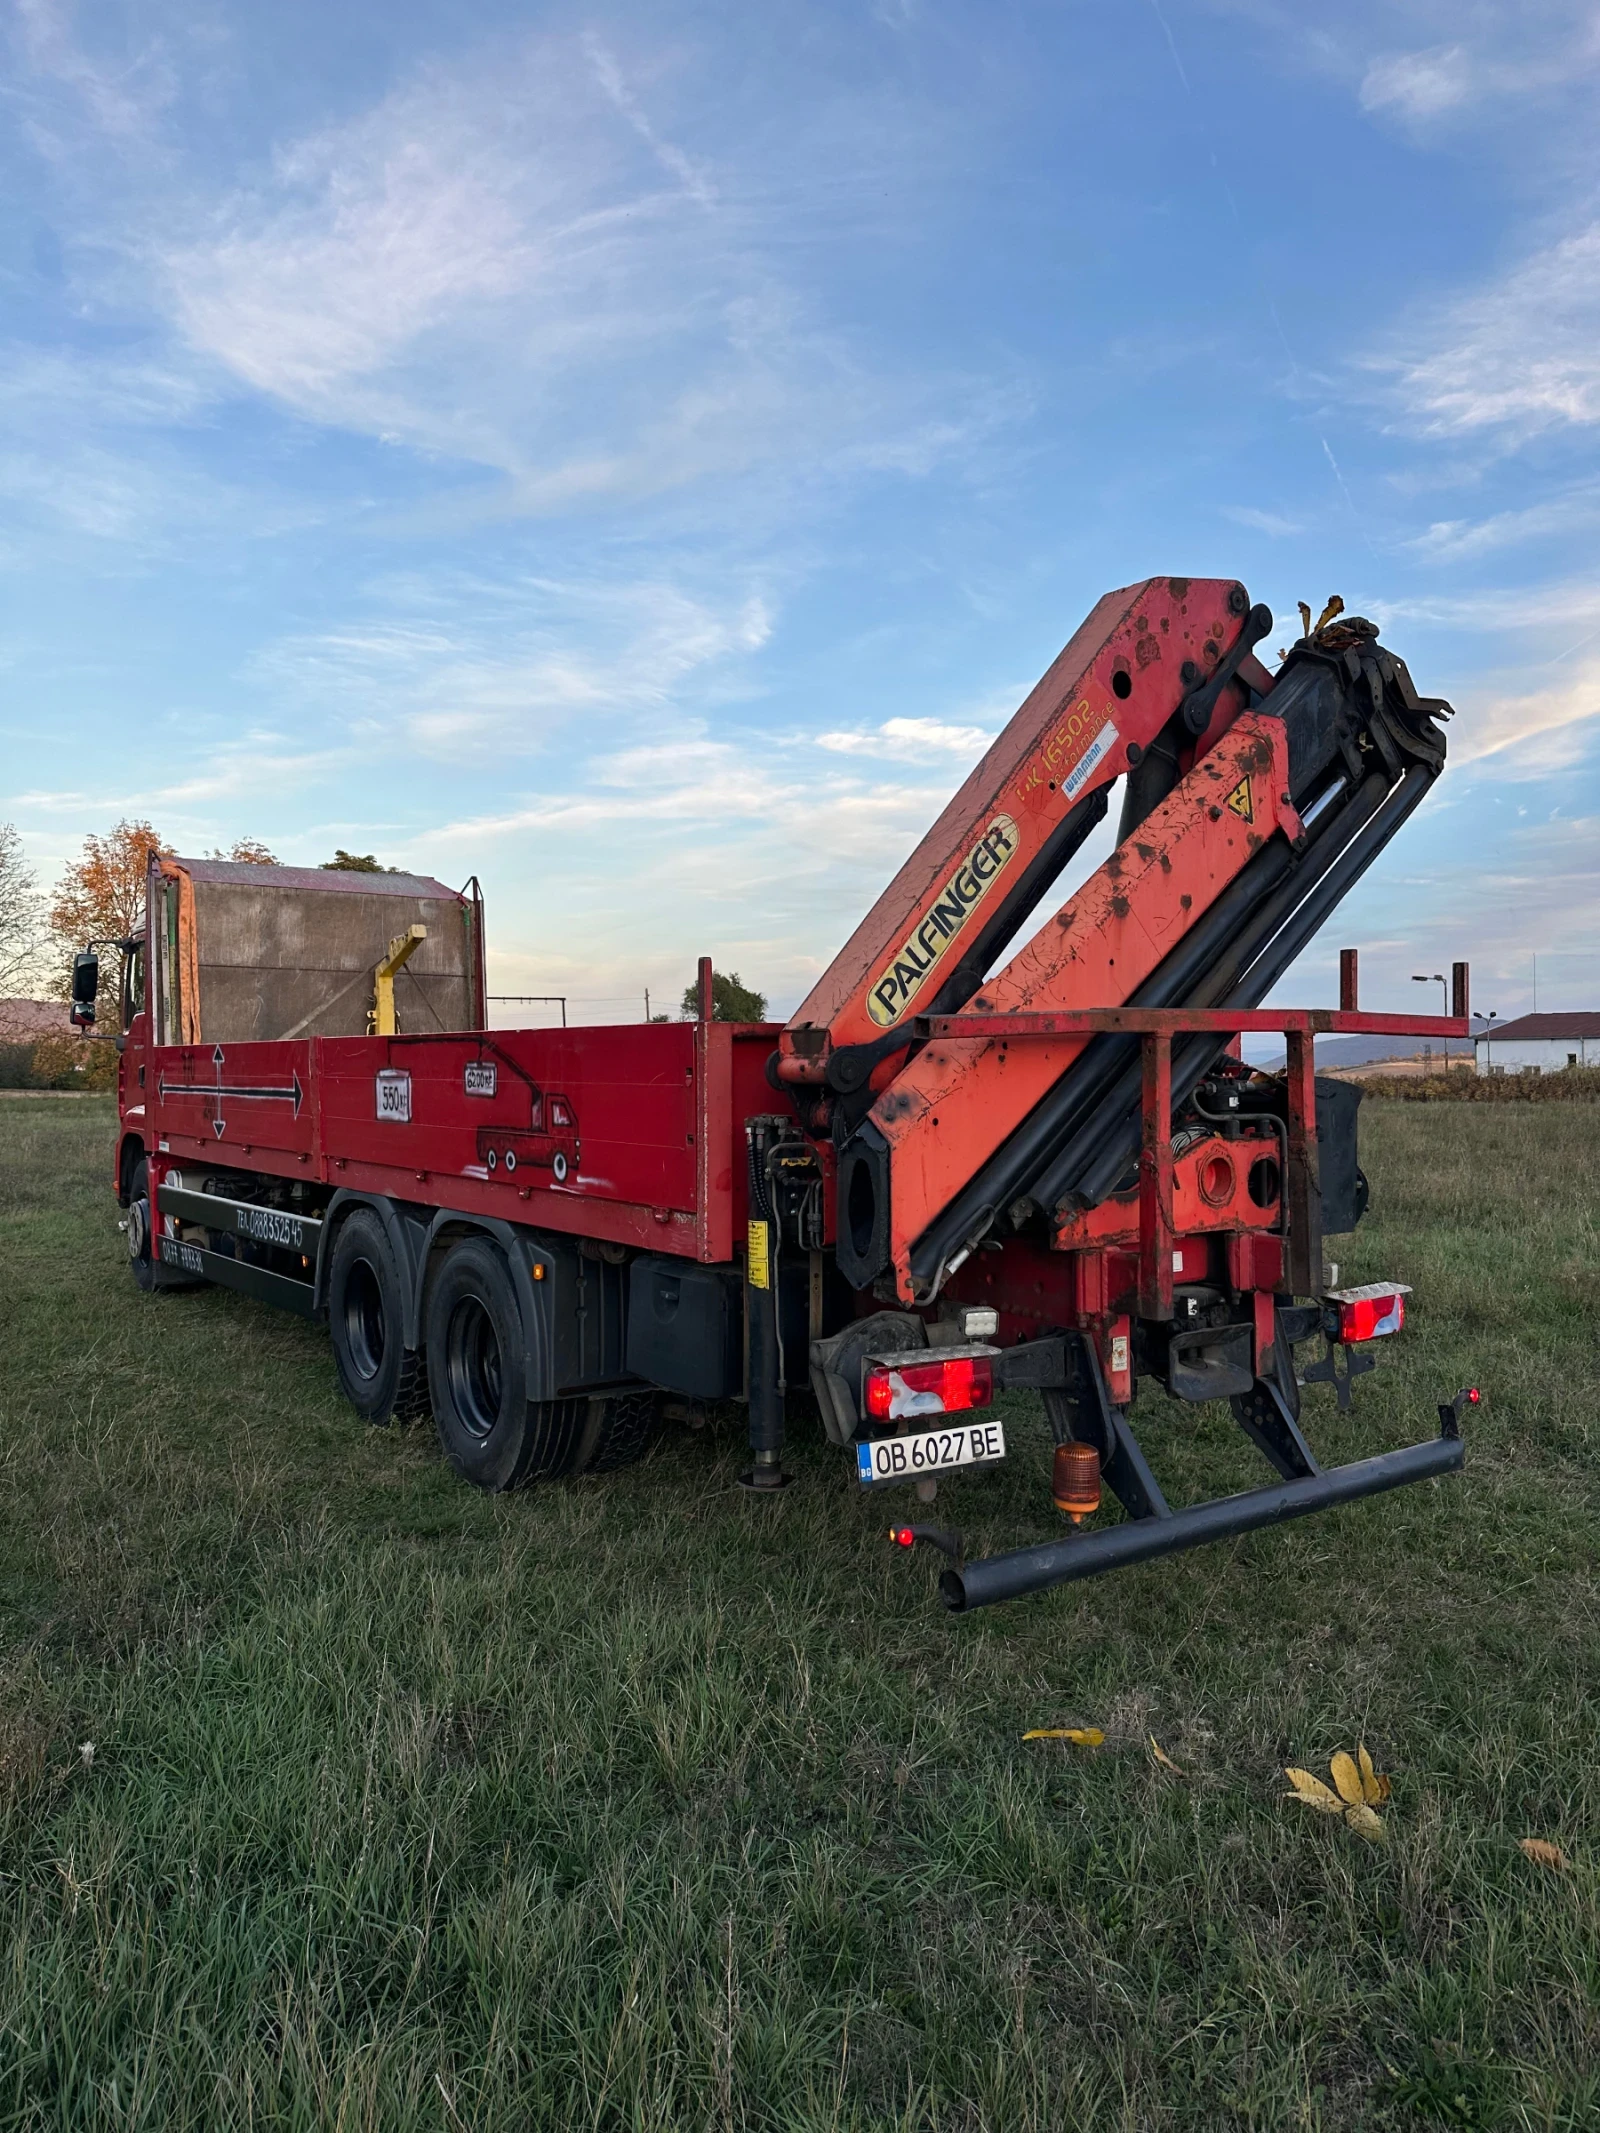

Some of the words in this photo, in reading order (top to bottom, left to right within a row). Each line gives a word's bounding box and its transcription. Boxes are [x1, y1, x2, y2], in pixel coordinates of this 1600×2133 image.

[1041, 699, 1095, 772] 16502
[874, 826, 1012, 1016] PALFINGER
[860, 1467, 872, 1478] BG
[876, 1443, 907, 1475] OB
[912, 1432, 965, 1468] 6027
[970, 1426, 1001, 1458] BE
